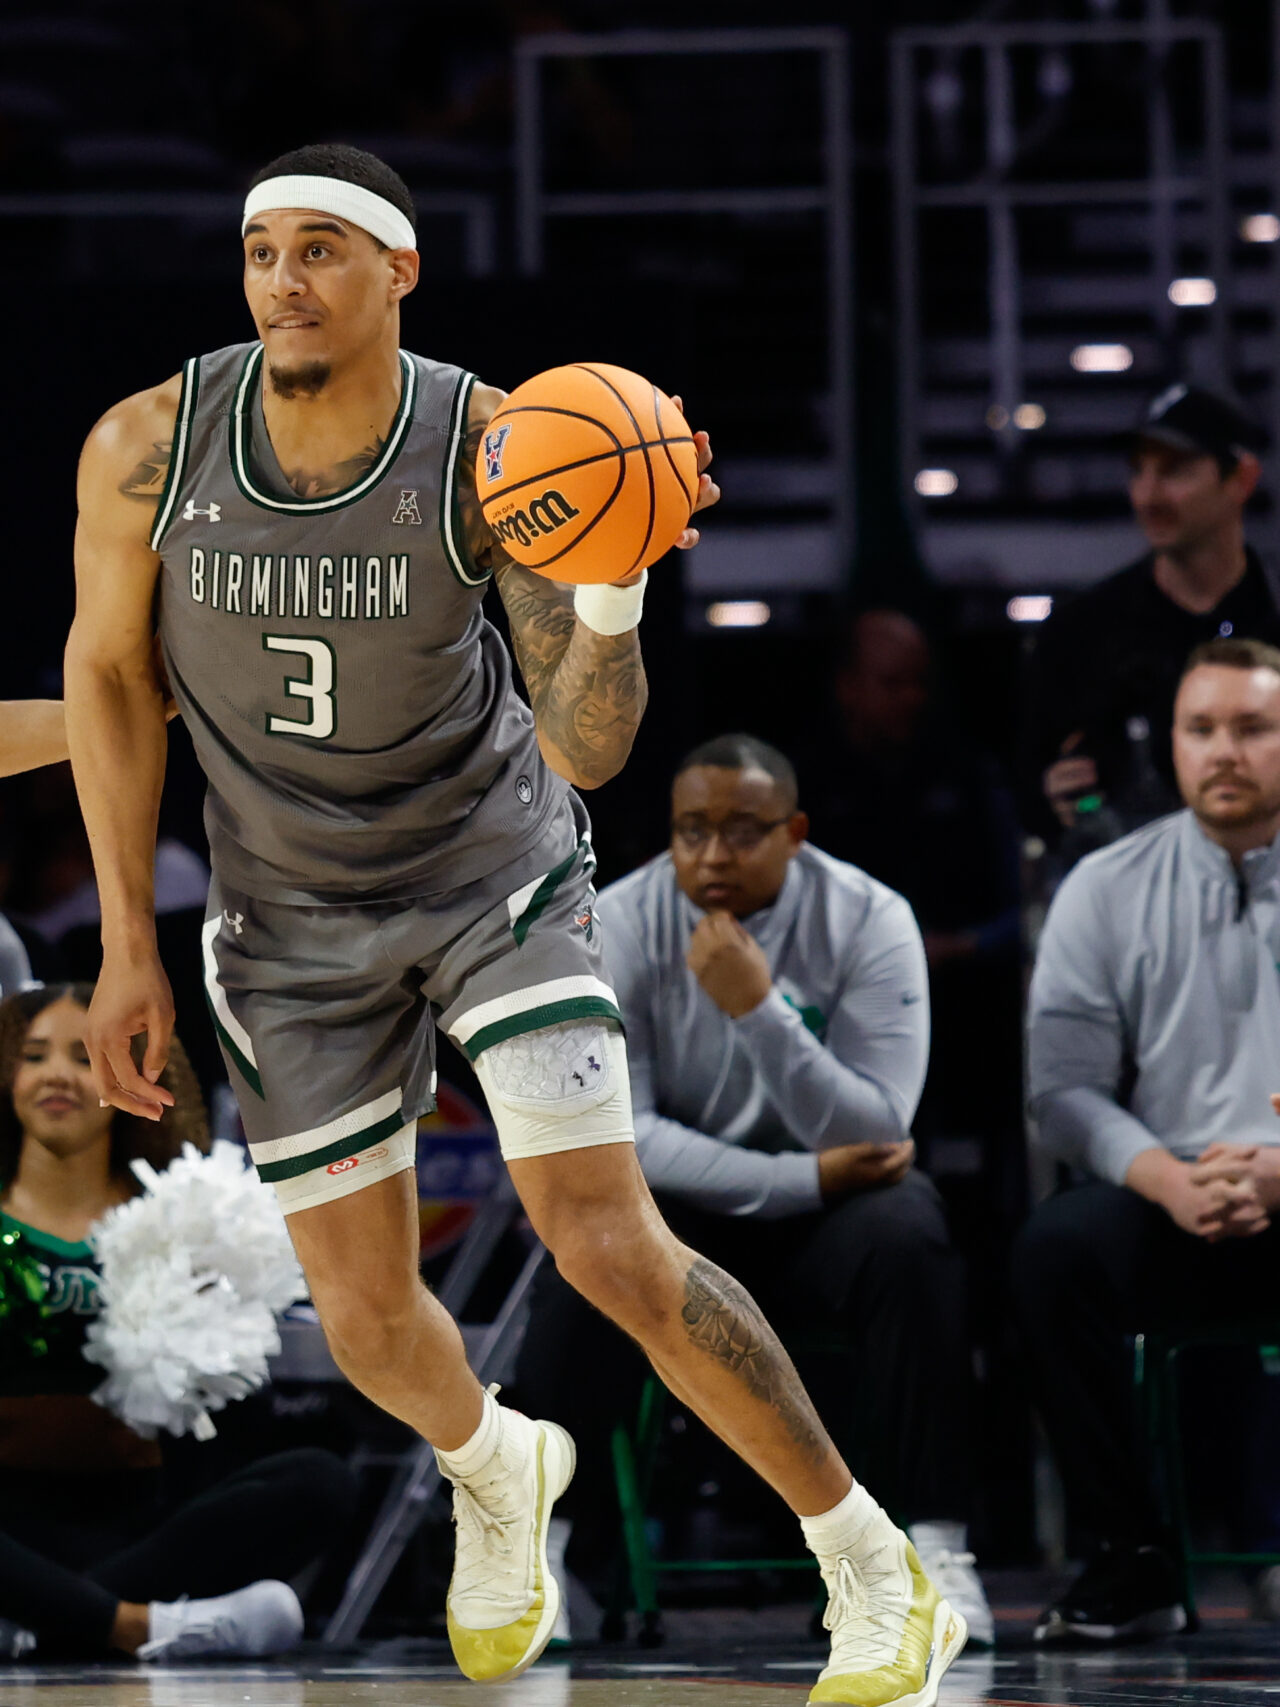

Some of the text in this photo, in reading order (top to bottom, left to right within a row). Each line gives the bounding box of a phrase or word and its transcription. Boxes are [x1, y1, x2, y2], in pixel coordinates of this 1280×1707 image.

[490, 489, 580, 547] Wilso
[190, 546, 410, 620] BIRMINGHAM
[262, 632, 338, 741] 3
